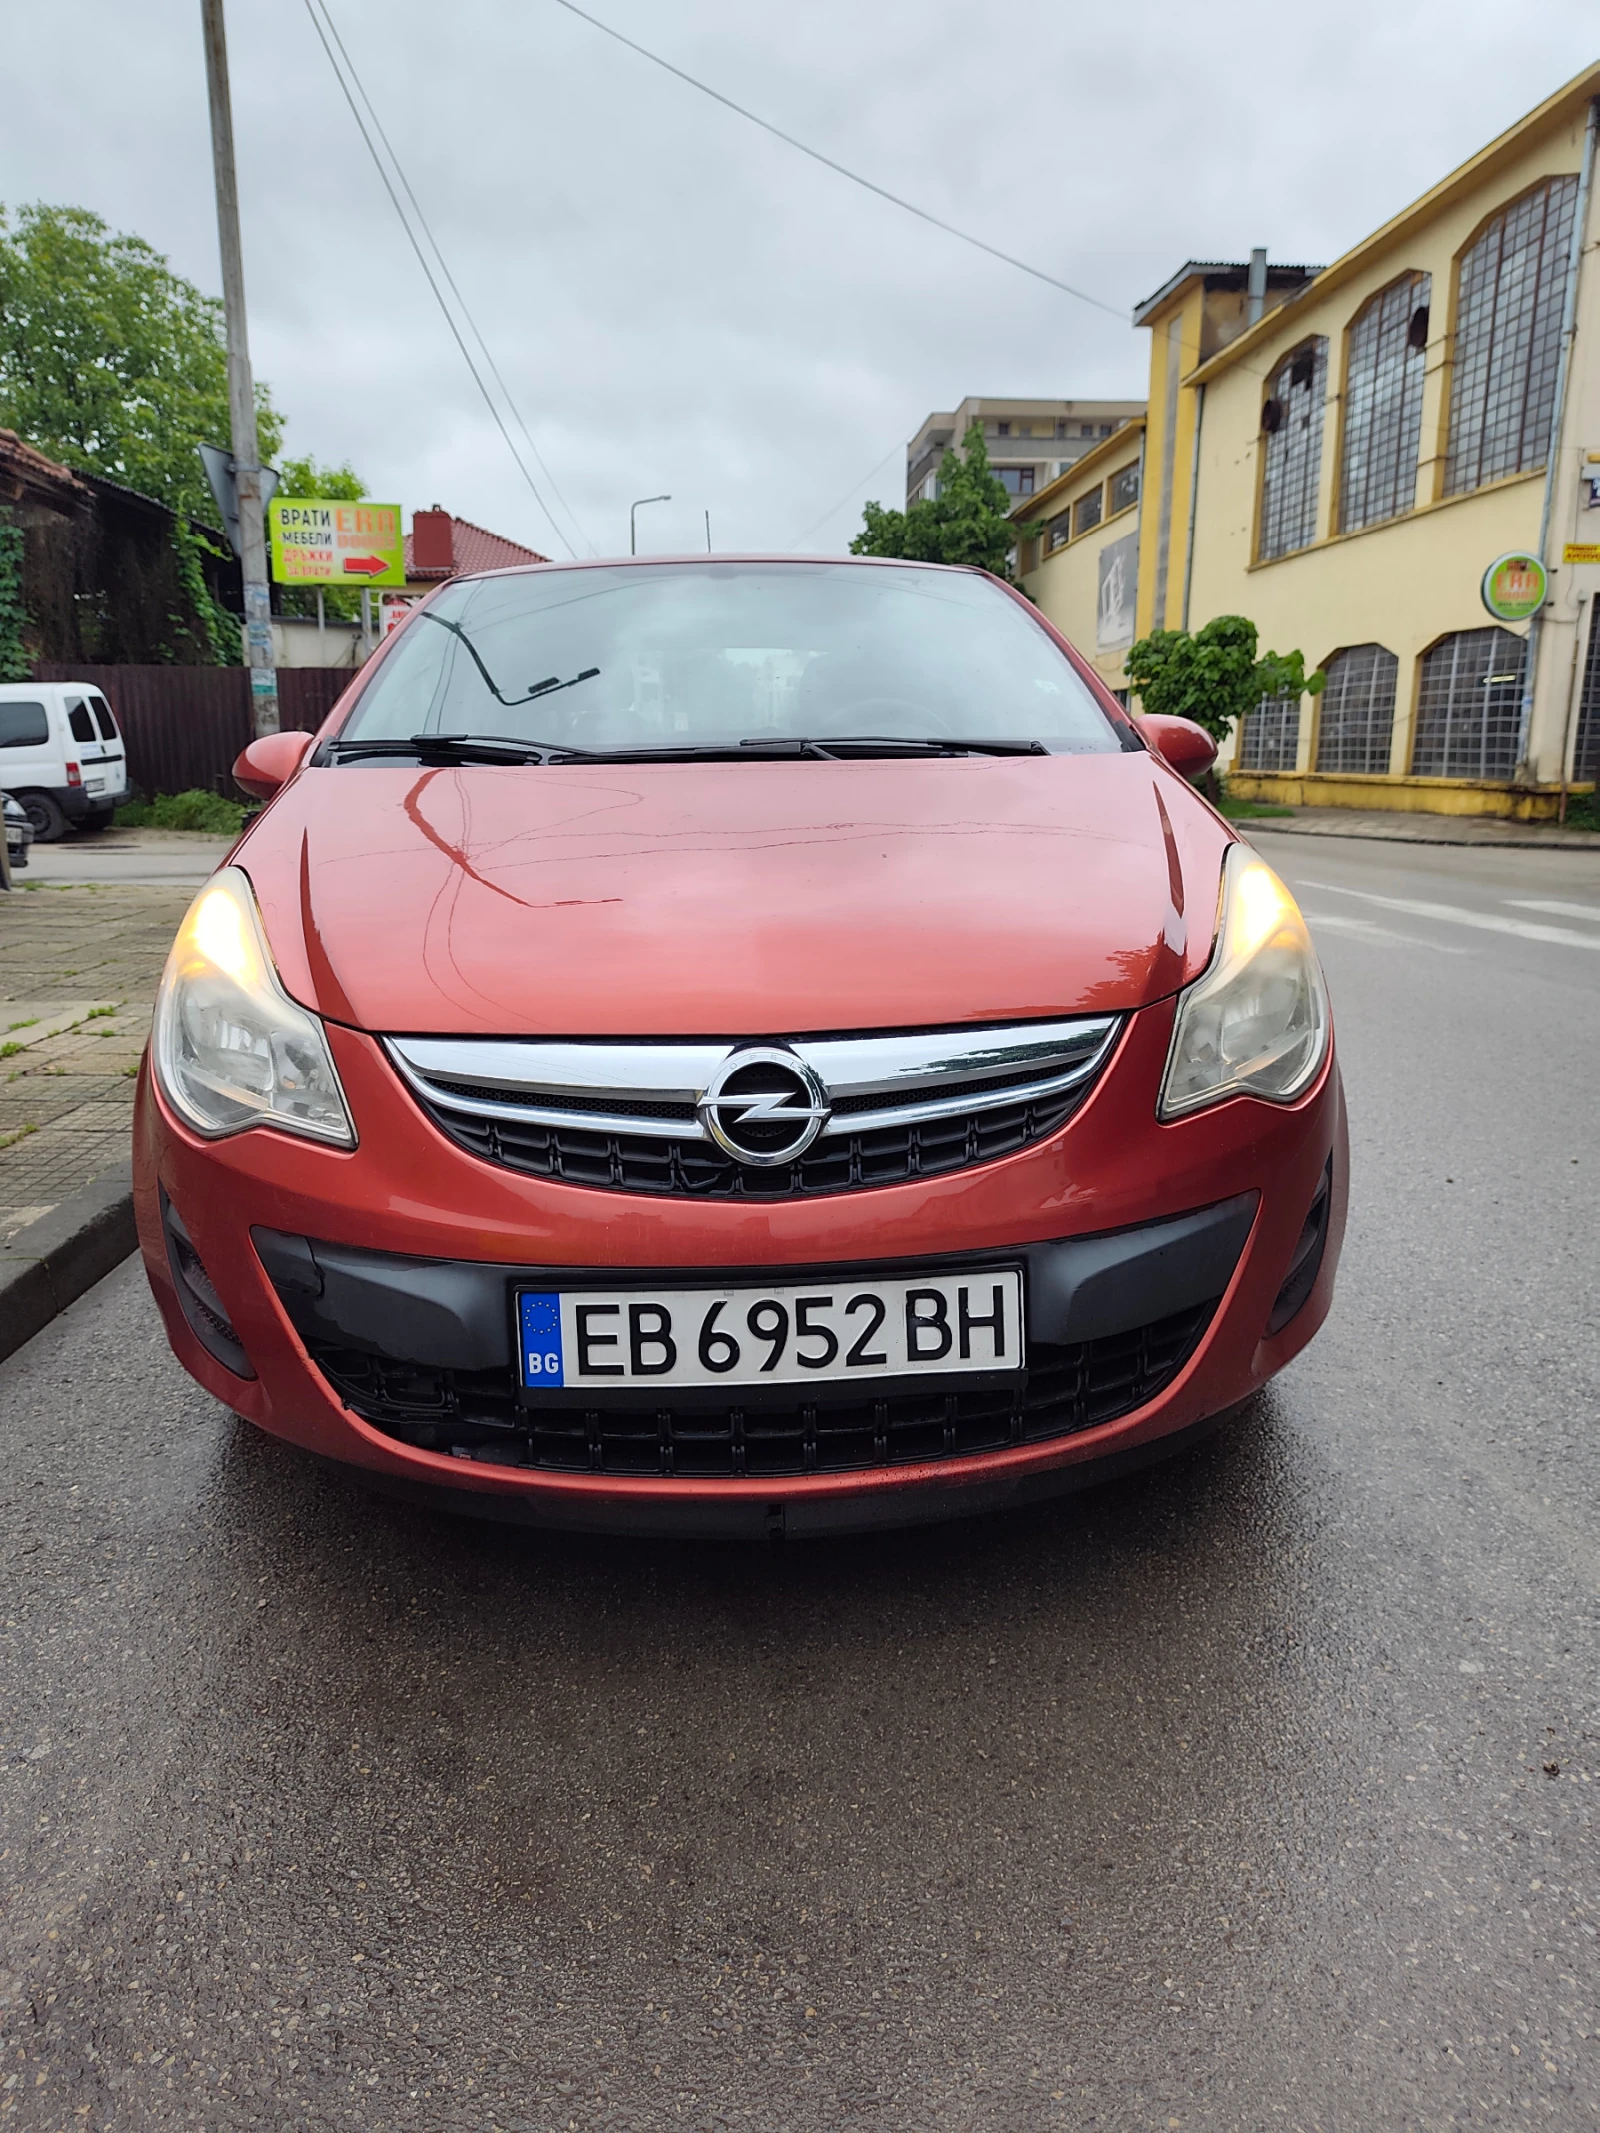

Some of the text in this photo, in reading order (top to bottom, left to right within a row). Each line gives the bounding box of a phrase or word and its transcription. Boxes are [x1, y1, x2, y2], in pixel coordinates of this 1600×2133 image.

[281, 508, 332, 527] ВРАТИ
[335, 508, 396, 534] ERA
[282, 531, 333, 546] МЕБЕЛИ
[729, 1053, 799, 1070] OPEL
[575, 1285, 1006, 1377] EB 6952 BH
[528, 1352, 559, 1375] BG
